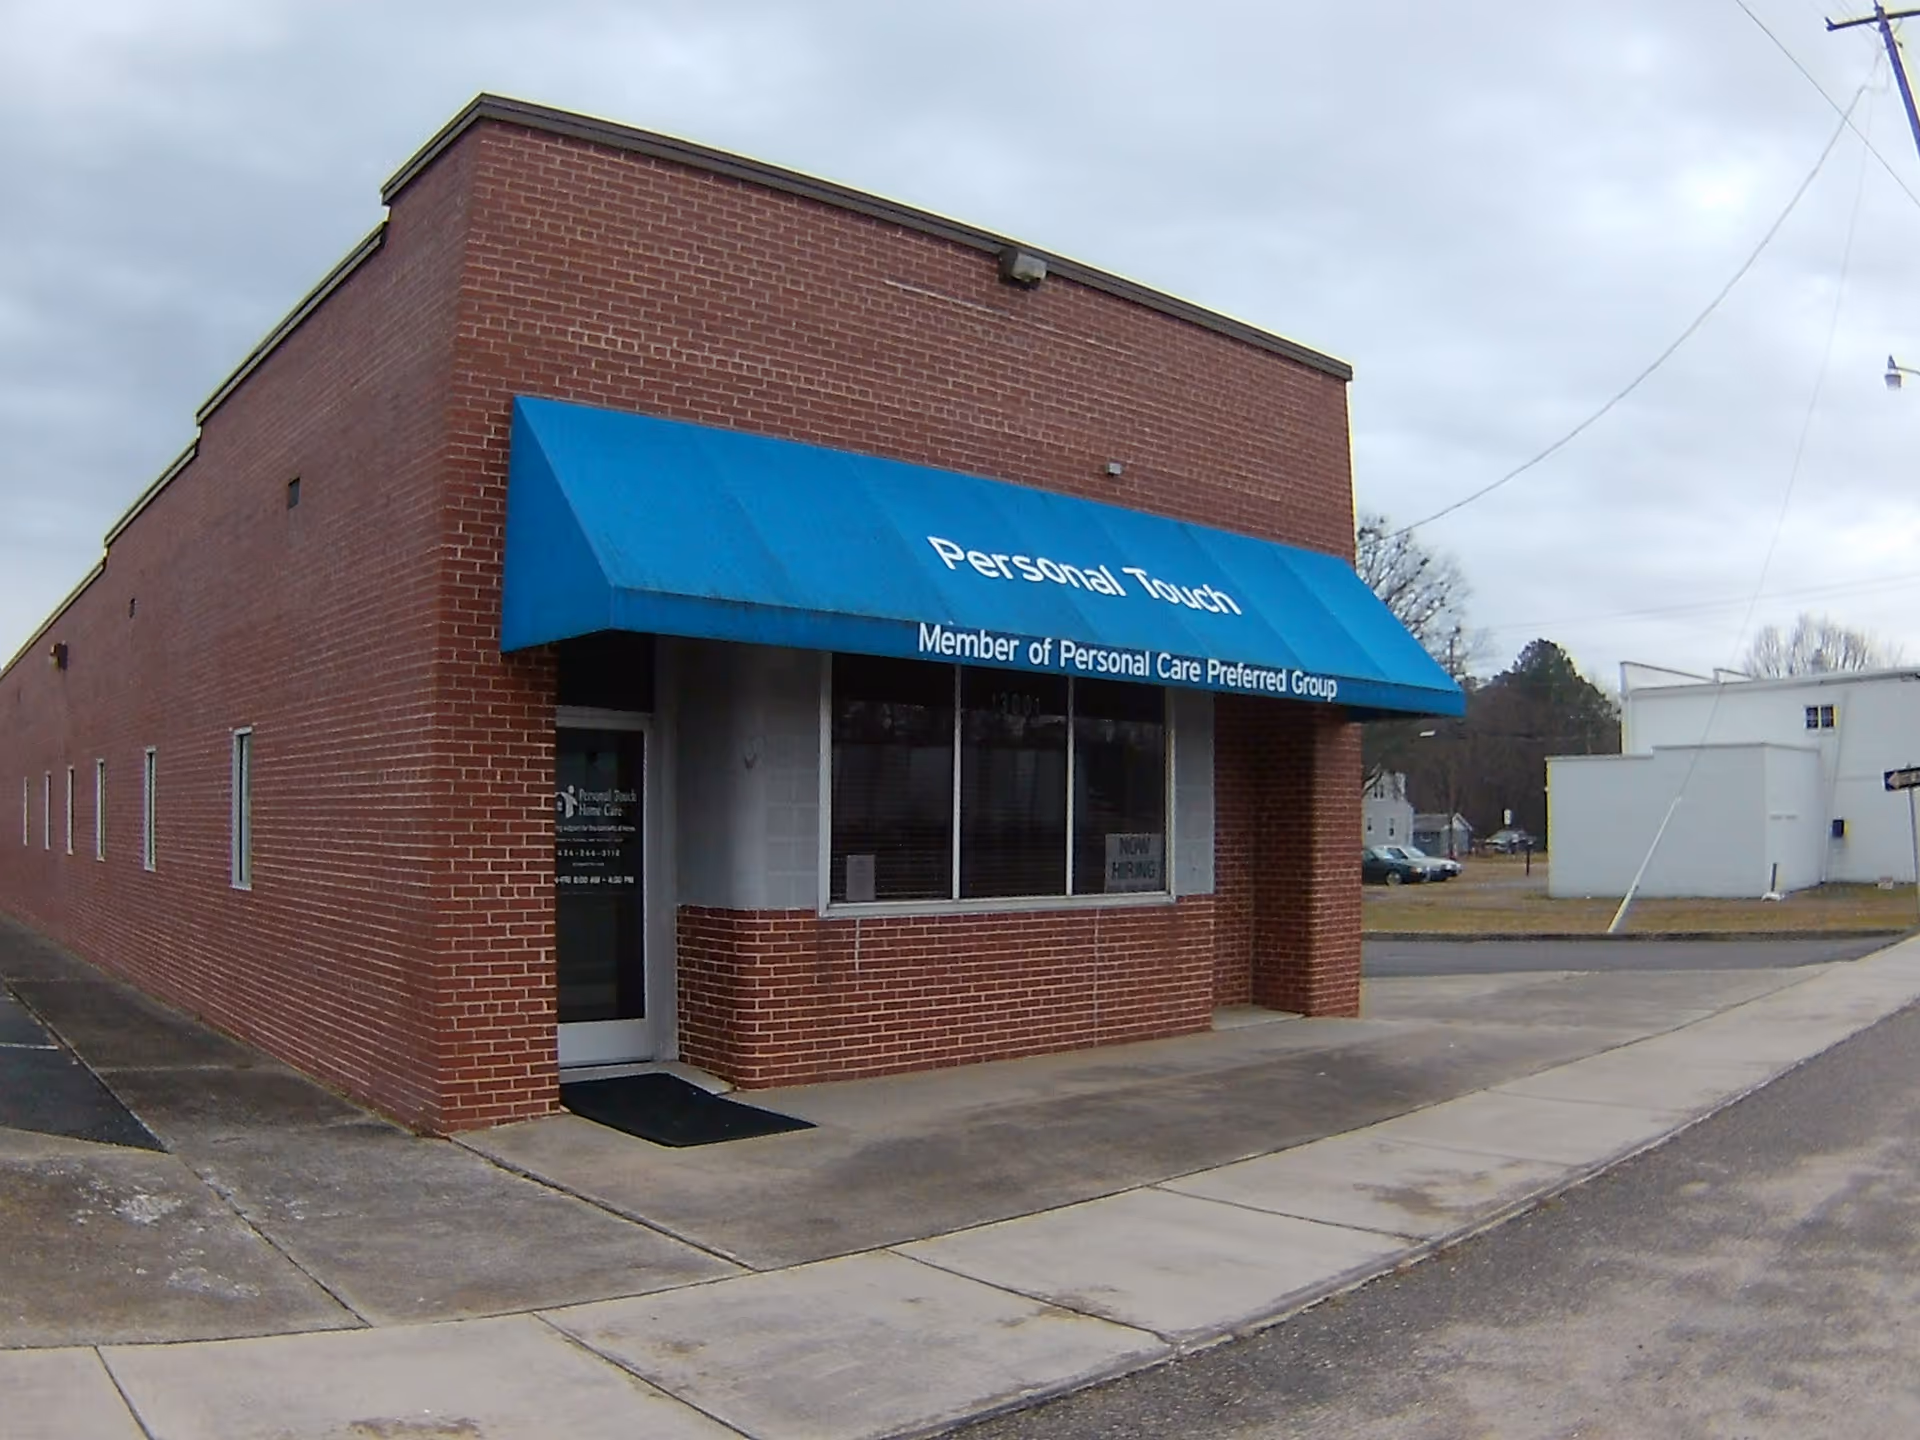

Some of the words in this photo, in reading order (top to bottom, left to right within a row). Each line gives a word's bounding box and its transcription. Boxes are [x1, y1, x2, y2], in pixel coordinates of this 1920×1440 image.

[927, 536, 1127, 597] Personal
[1121, 567, 1242, 616] Touch
[918, 622, 1020, 662] Member
[1028, 637, 1052, 666] of
[1059, 640, 1150, 677] Personal
[1156, 653, 1201, 683] Care
[1207, 659, 1287, 693] Preferred
[1291, 670, 1338, 702] Group
[603, 803, 623, 816] Care
